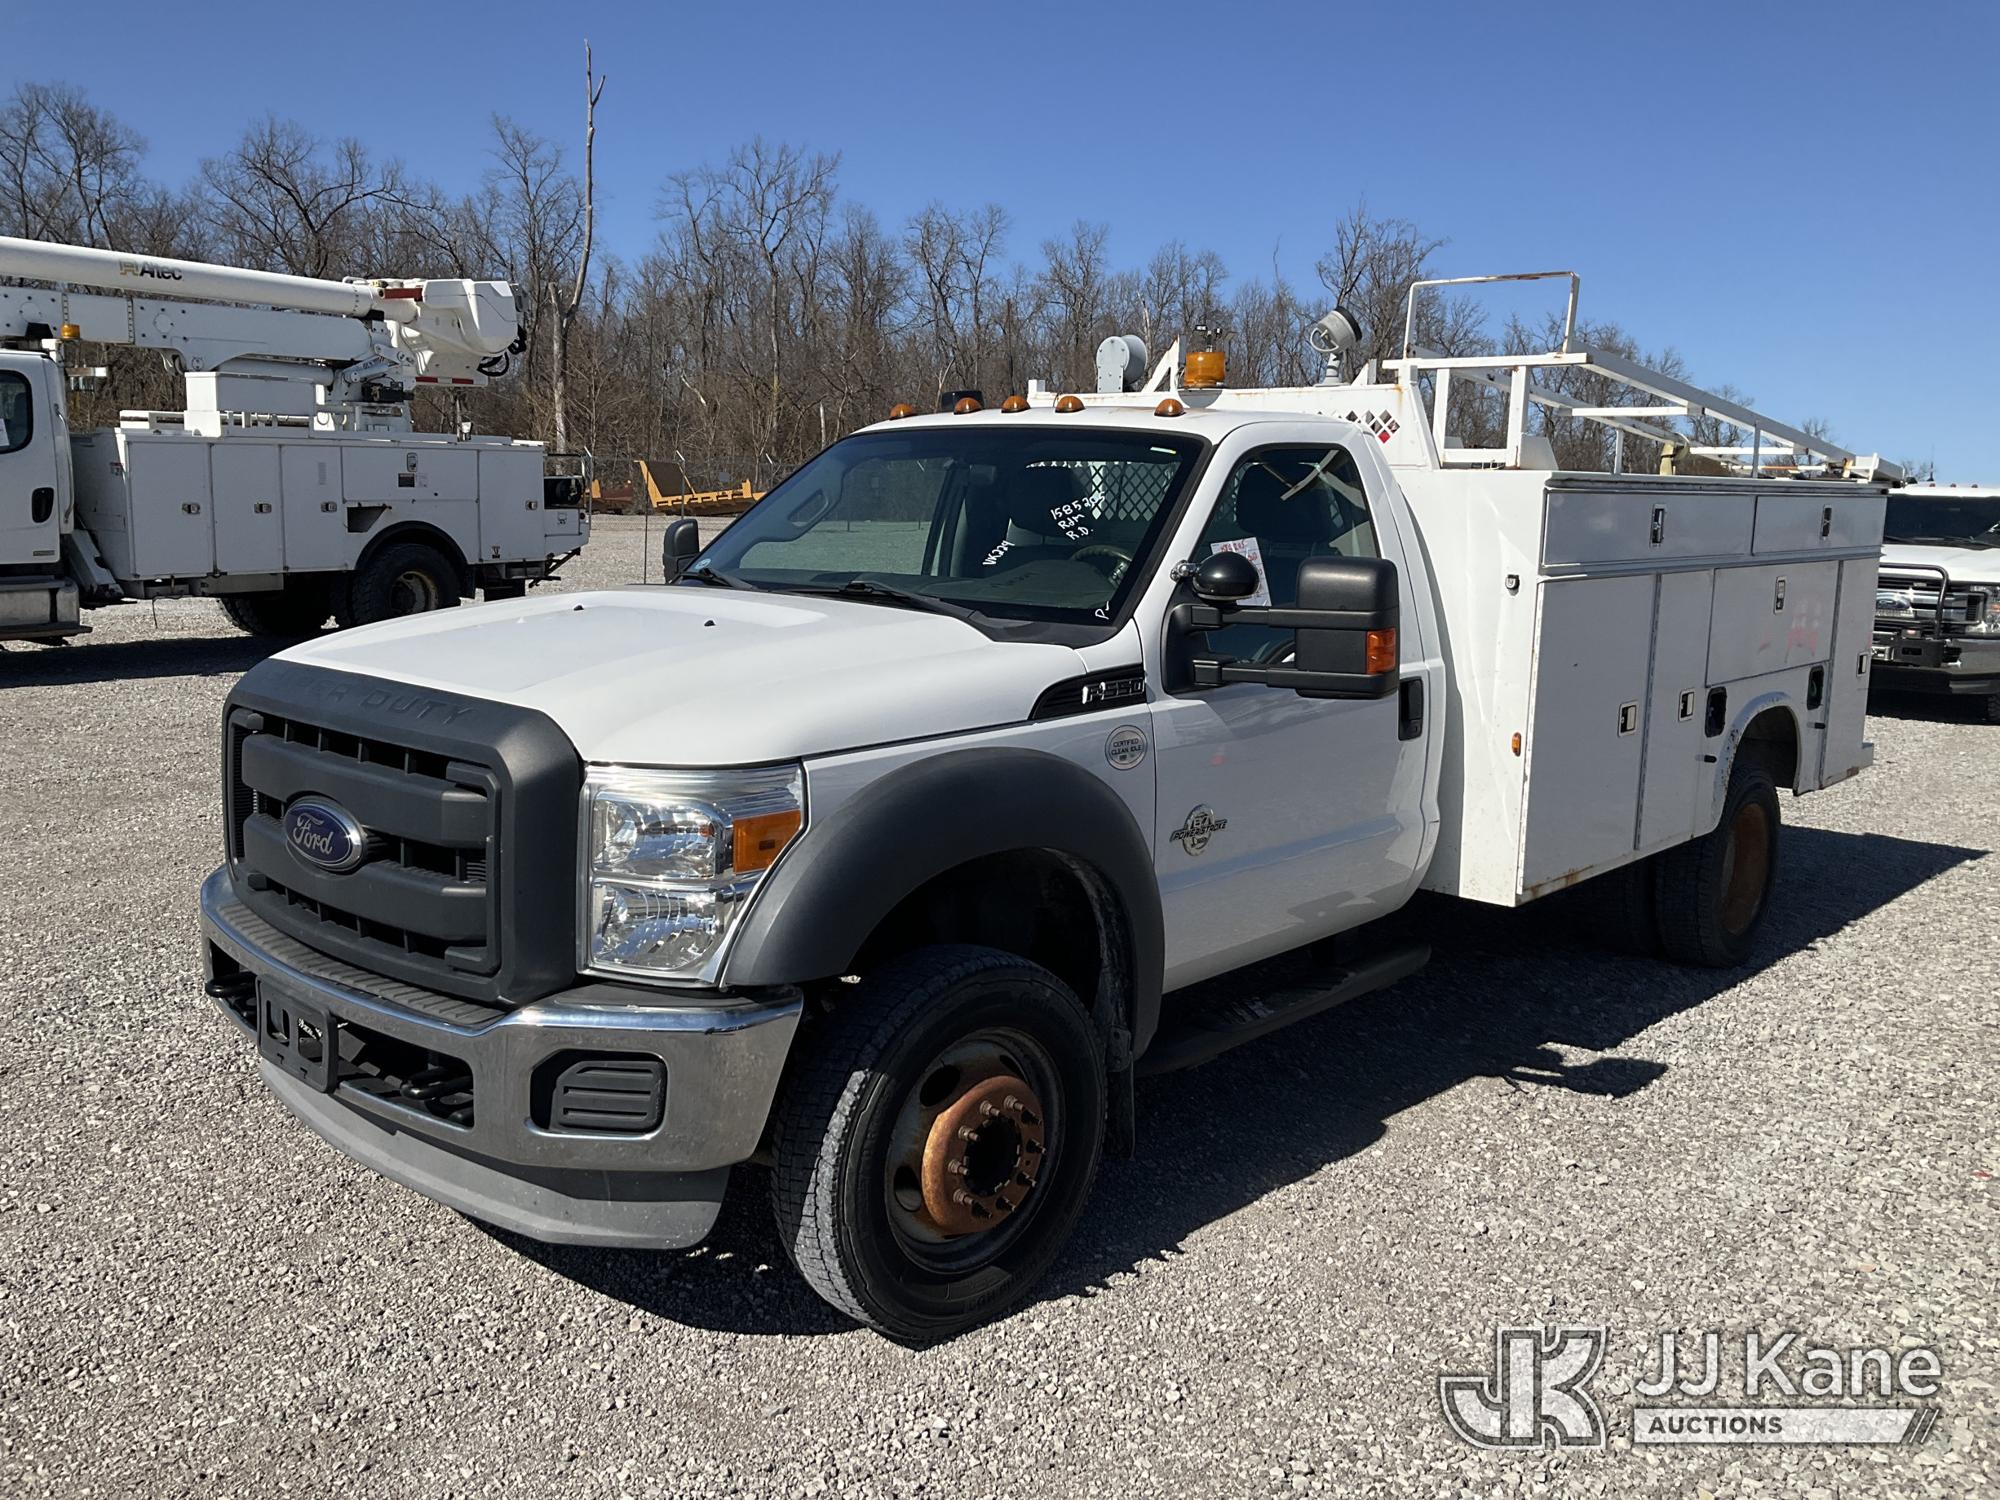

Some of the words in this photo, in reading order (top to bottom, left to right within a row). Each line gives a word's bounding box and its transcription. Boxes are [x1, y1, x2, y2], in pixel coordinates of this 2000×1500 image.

[140, 261, 183, 280] Altec
[1050, 491, 1106, 520] 1585205
[361, 690, 474, 725] DUTY
[1111, 746, 1129, 755] CLEAN
[293, 812, 334, 854] Ford
